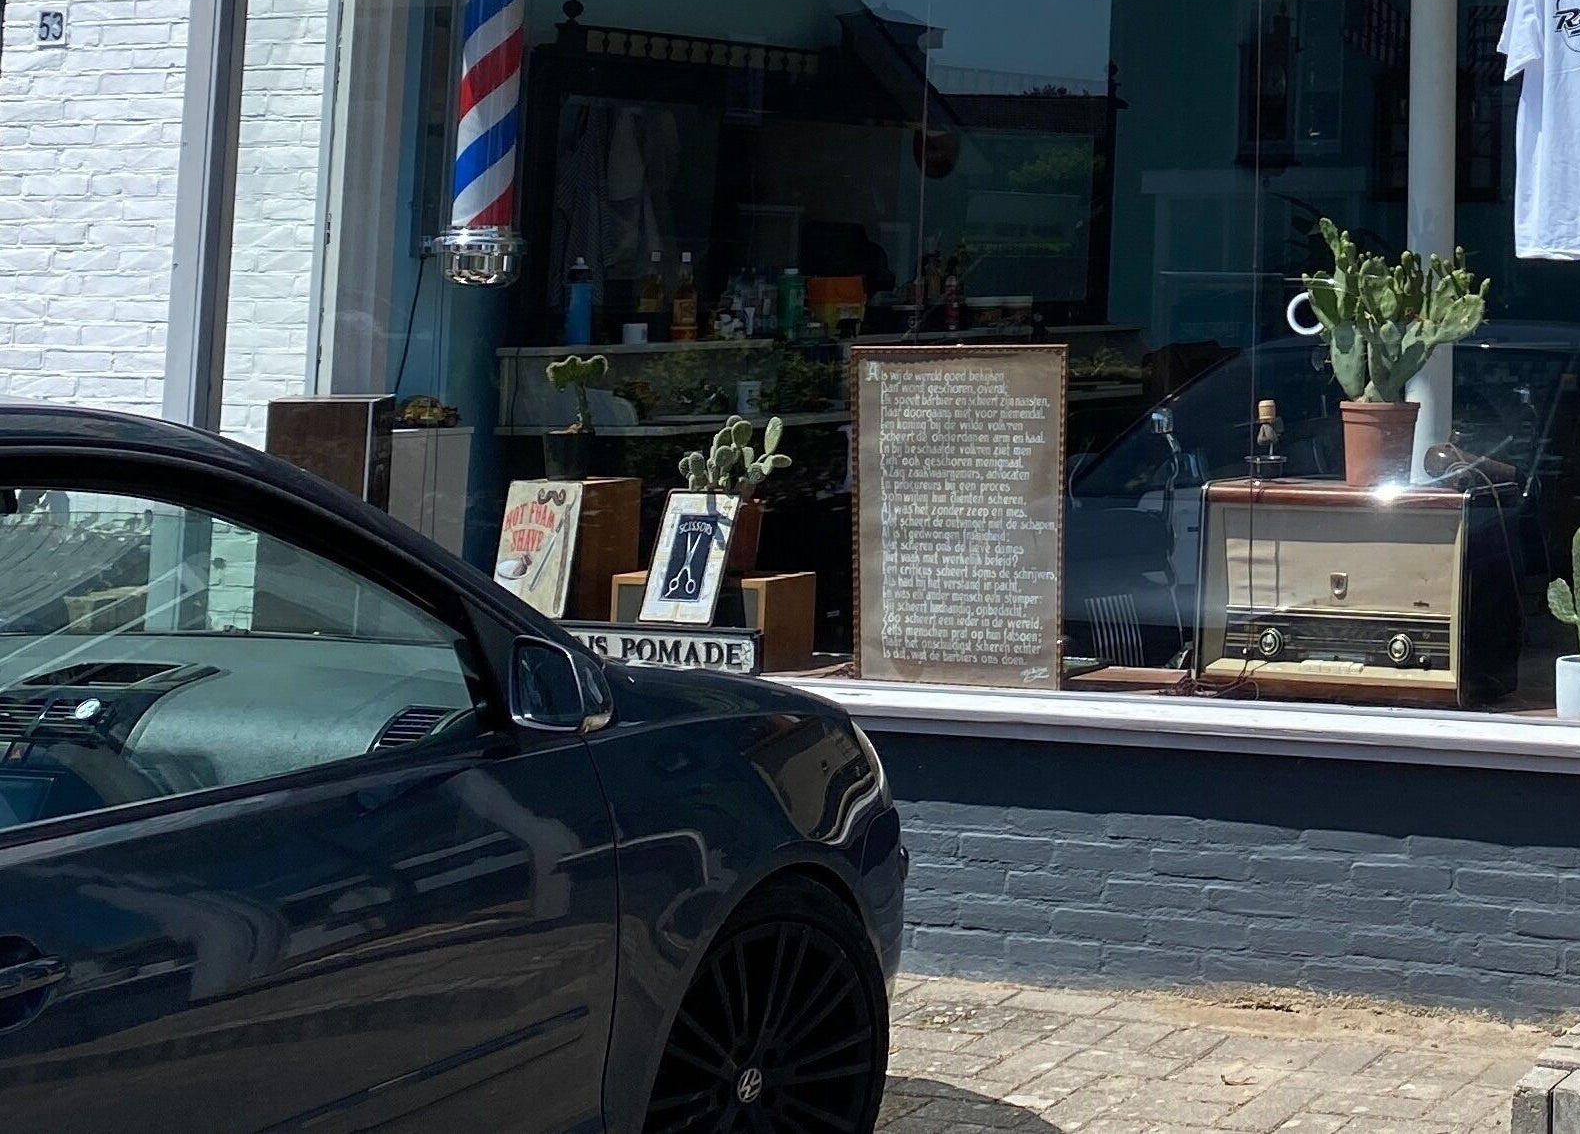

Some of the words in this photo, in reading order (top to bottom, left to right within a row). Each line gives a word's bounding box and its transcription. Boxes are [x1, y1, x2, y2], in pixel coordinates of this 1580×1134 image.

[38, 11, 64, 41] 53
[903, 370, 913, 380] de
[944, 371, 967, 385] goed
[955, 397, 967, 406] en
[968, 395, 998, 406] scheert
[903, 407, 952, 422] doorgaans
[975, 409, 998, 418] voor
[944, 419, 956, 429] de
[880, 430, 916, 442] Scheert
[917, 432, 928, 442] de
[932, 431, 990, 443] onderdanen
[993, 434, 1010, 442] arm
[1013, 435, 1024, 443] en
[1013, 447, 1032, 455] men
[902, 455, 921, 466] ook
[924, 456, 973, 470] geschoren
[986, 469, 1030, 481] advocaten
[959, 482, 977, 491] een
[980, 482, 1011, 496] proces
[894, 506, 913, 515] was
[914, 504, 929, 515] het
[931, 504, 964, 516] zonder
[966, 508, 989, 523] zeep
[990, 508, 1003, 516] en
[900, 516, 931, 527] scheert
[932, 516, 944, 527] de
[1006, 518, 1018, 530] de
[511, 528, 545, 553] SHAVE
[935, 543, 952, 552] ons
[954, 542, 966, 553] de
[994, 542, 1025, 554] dames
[985, 555, 1019, 568] beleid?
[935, 565, 969, 578] scheert
[973, 569, 998, 578] soms
[999, 567, 1011, 579] de
[904, 613, 937, 625] scheert
[938, 617, 955, 626] een
[982, 618, 991, 627] in
[992, 617, 1004, 628] de
[971, 631, 984, 645] op
[620, 637, 743, 670] POMADE
[975, 640, 1011, 653] scheren
[1012, 643, 1041, 655] echter
[929, 650, 941, 660] de
[980, 655, 999, 664] ons
